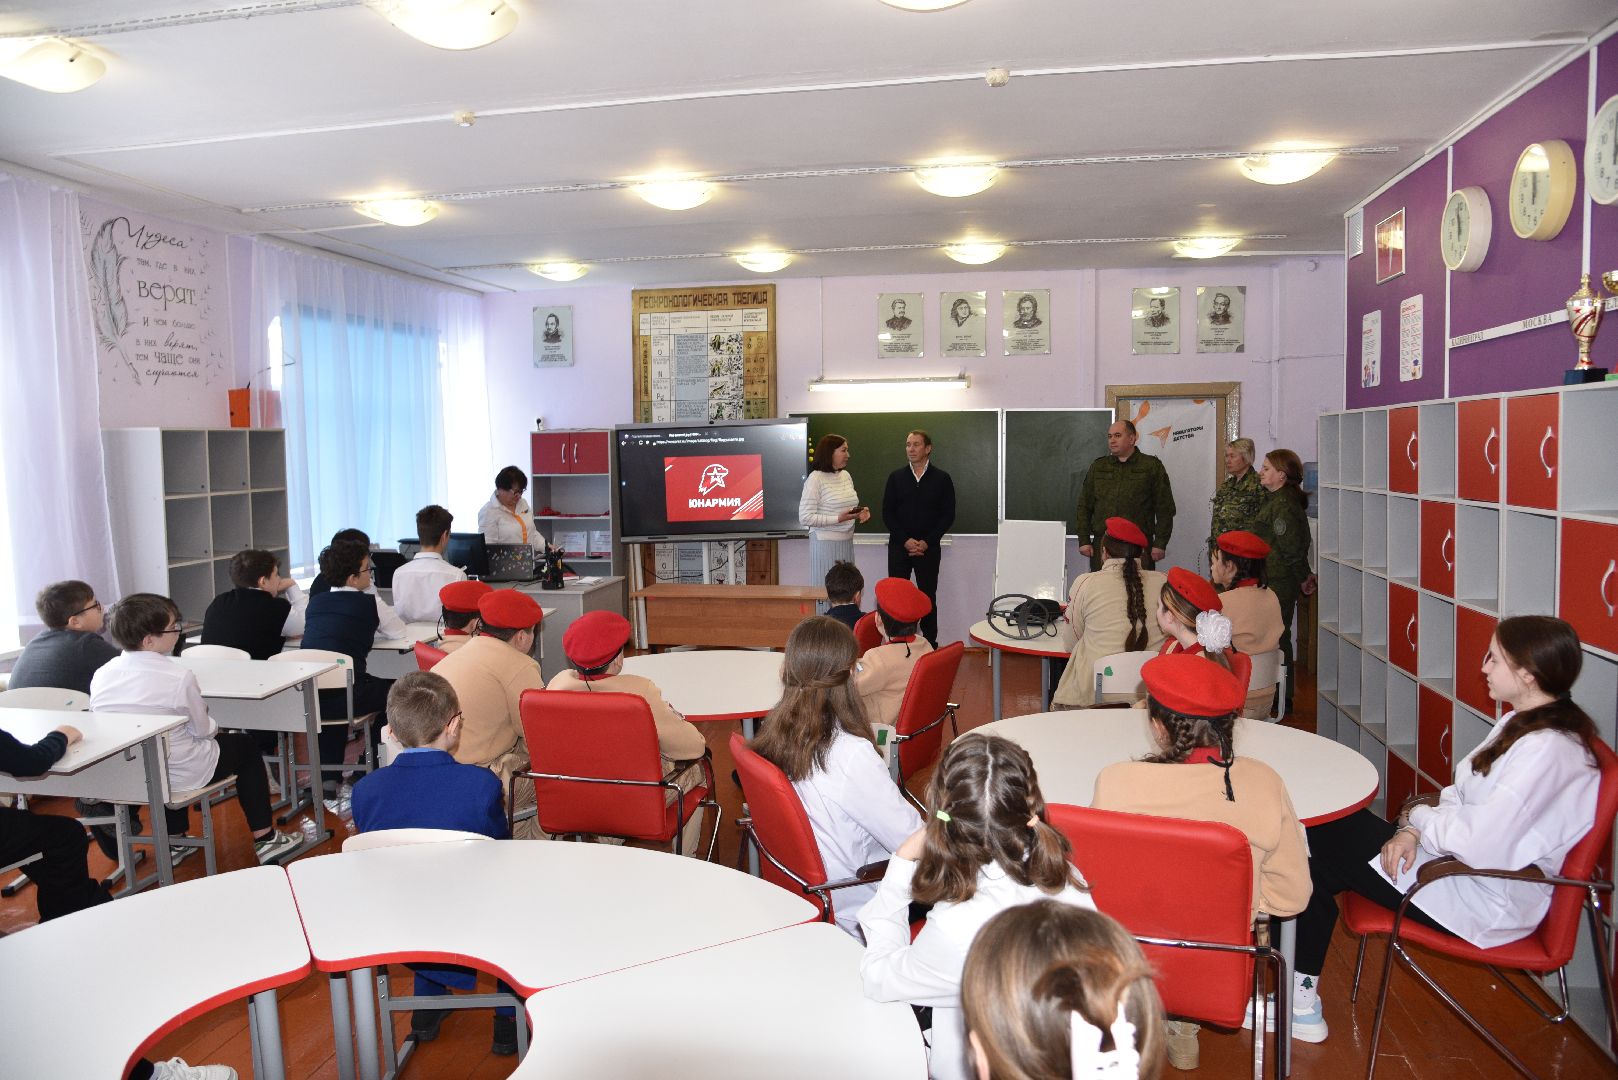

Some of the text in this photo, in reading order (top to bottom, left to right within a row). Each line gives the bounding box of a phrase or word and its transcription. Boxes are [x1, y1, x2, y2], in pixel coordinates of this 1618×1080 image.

[111, 217, 188, 250] Чудеса
[639, 291, 768, 309] ГЕОХРОНОЛОГИЧЕСКАЯ ТАБЛИЦА
[1522, 313, 1553, 329] МОСКВА
[1172, 425, 1204, 436] НАВИГАТОРЫ
[1172, 433, 1195, 442] ДЕТСТВА
[688, 497, 741, 509] ЮНАРМИЯ
